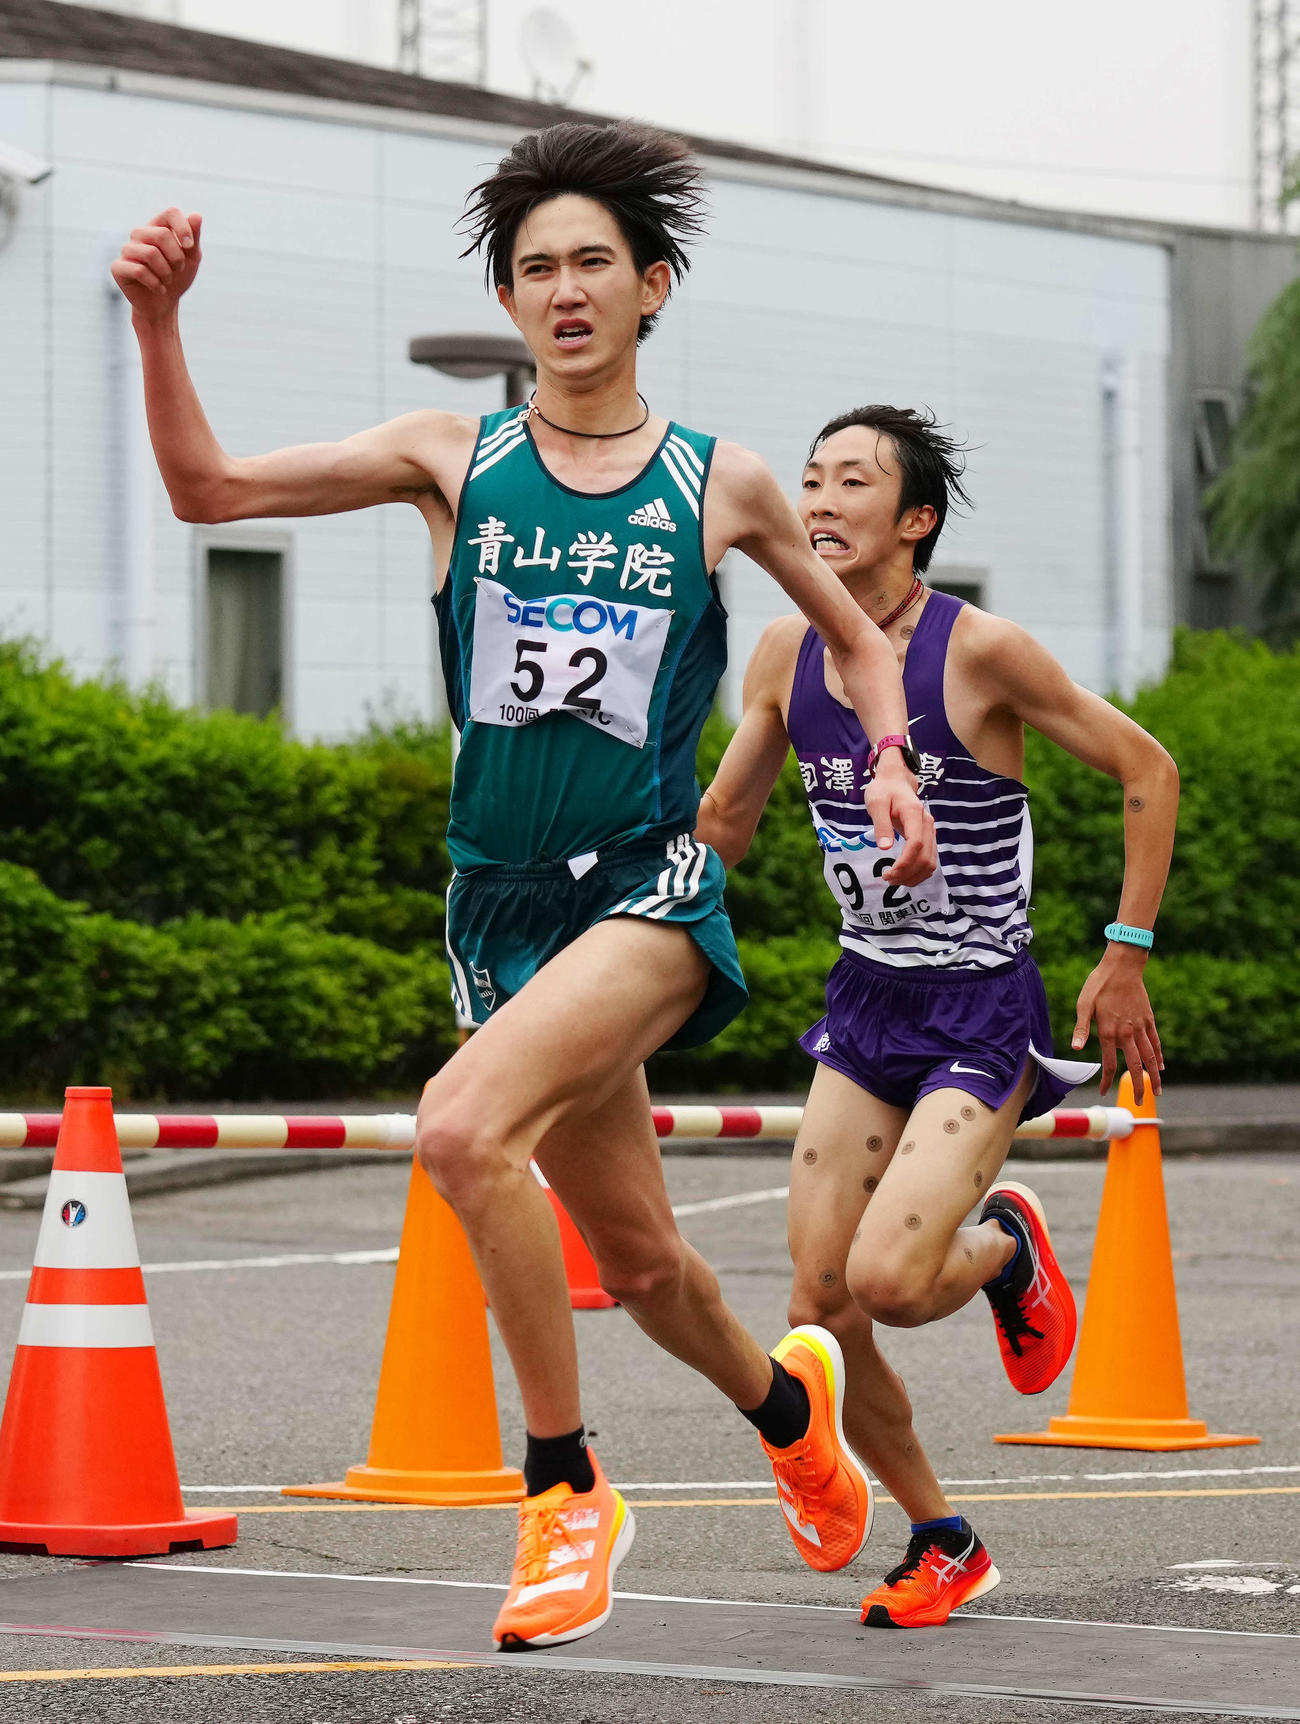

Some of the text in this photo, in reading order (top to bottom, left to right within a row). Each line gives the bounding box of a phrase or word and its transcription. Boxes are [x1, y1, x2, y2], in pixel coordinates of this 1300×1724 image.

[627, 512, 677, 533] adidas
[467, 515, 676, 598] 青山学院
[503, 592, 638, 641] SECOM
[509, 638, 609, 710] 52
[832, 856, 913, 912] 92
